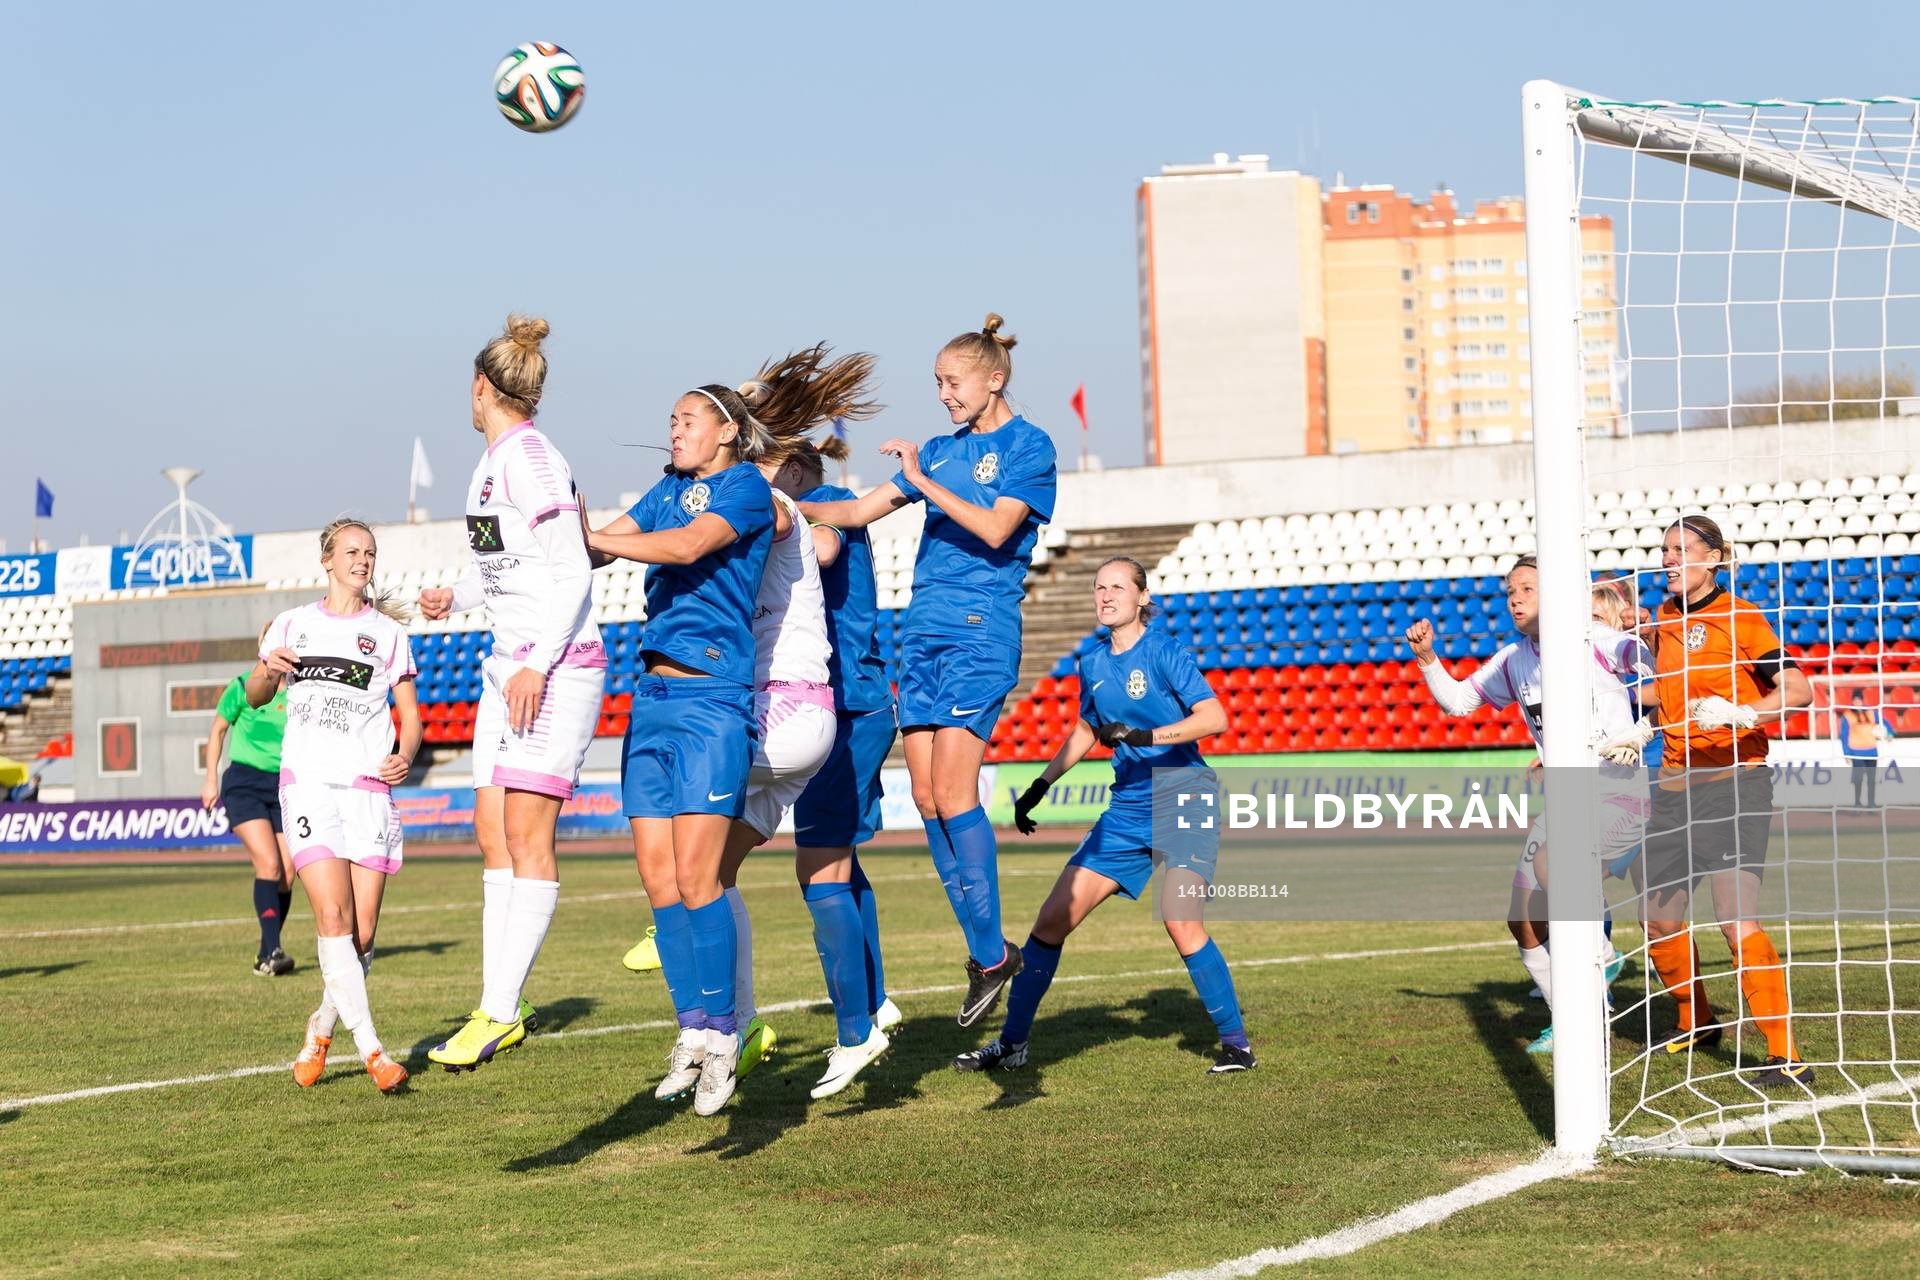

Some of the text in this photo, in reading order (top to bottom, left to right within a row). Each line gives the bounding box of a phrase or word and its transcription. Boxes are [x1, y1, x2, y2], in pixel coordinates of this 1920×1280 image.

[105, 723, 132, 770] 0
[69, 807, 230, 841] CHAMPIONS
[297, 815, 312, 838] 3
